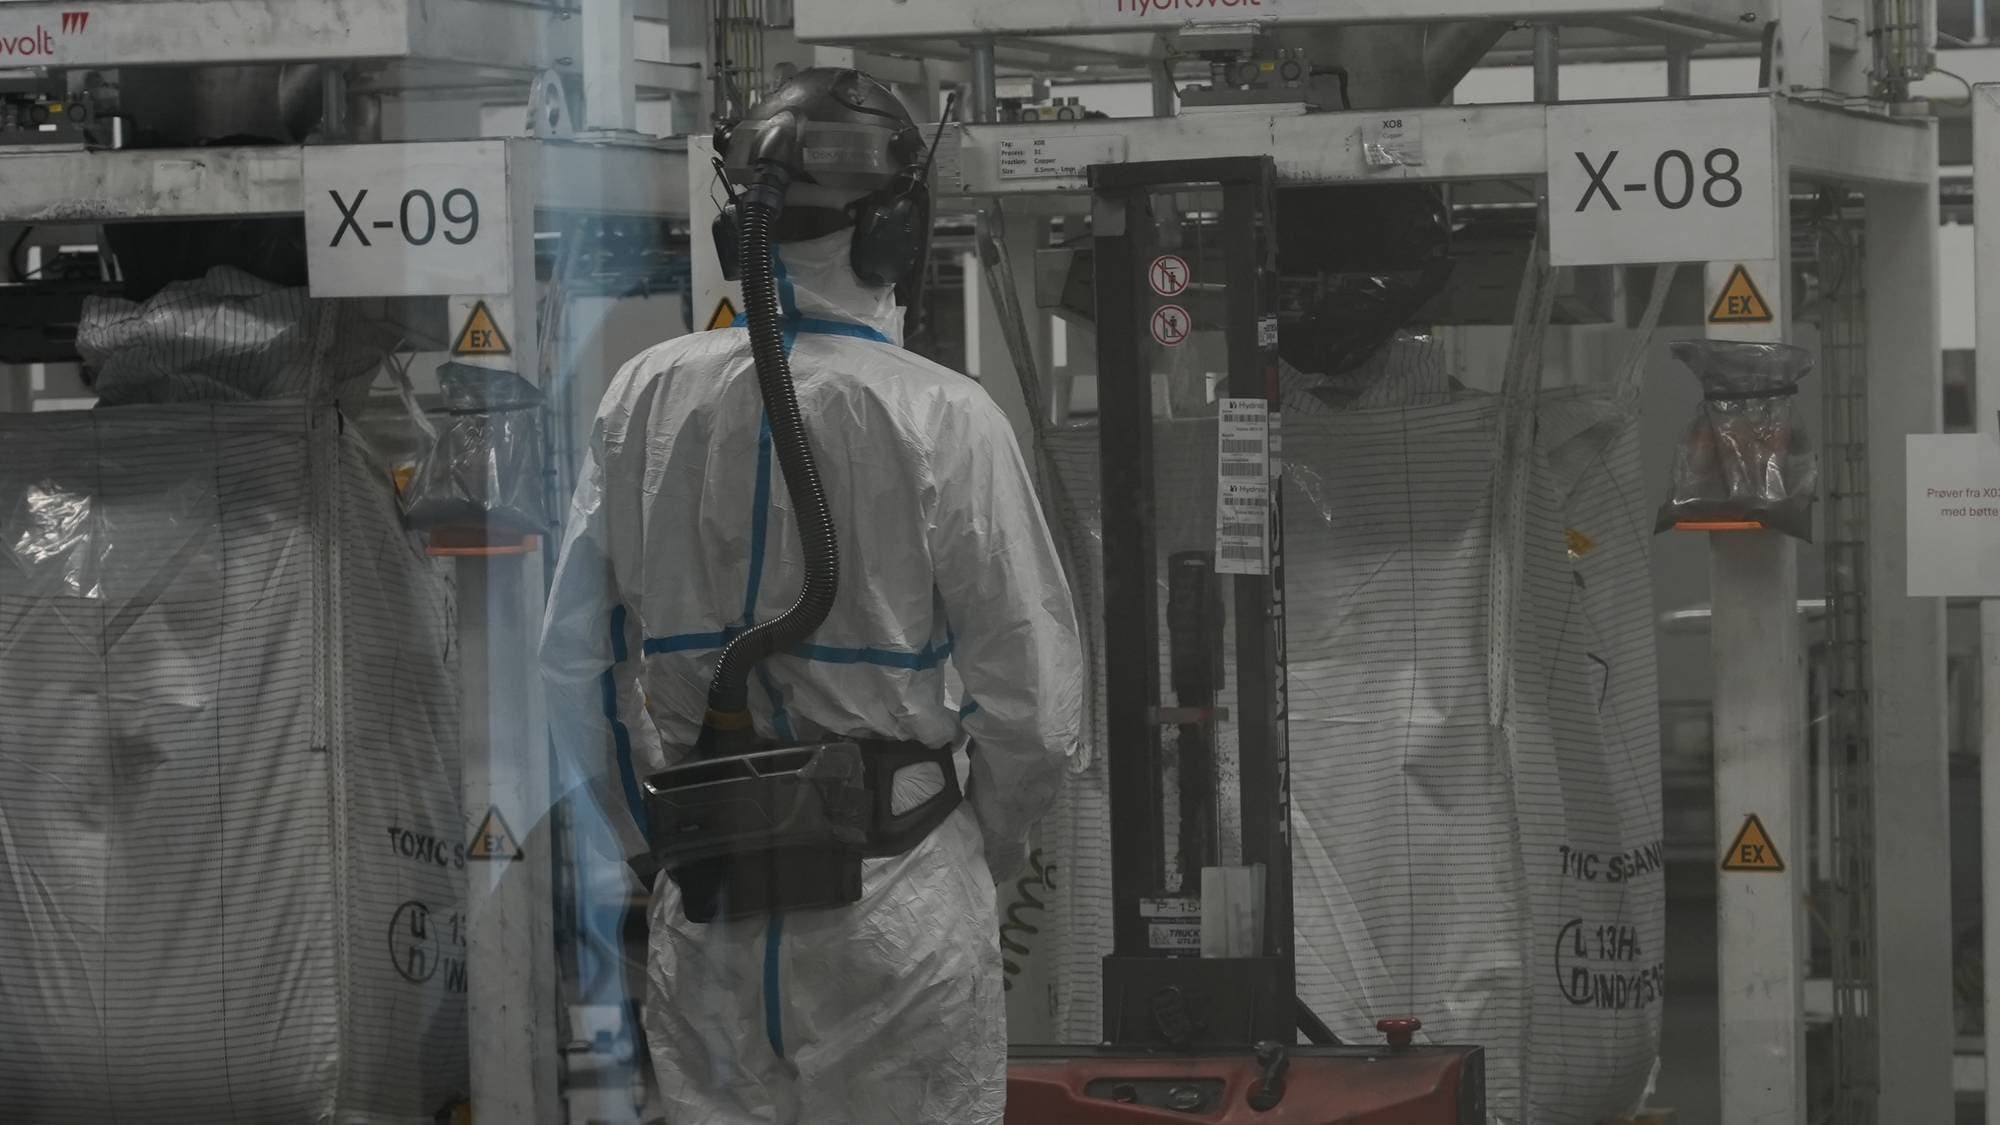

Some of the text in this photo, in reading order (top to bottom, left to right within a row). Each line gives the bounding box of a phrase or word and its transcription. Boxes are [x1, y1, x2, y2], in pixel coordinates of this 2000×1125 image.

[0, 25, 53, 55] volt
[1574, 148, 1742, 213] X-08
[329, 188, 479, 247] X-09
[1728, 295, 1752, 314] EX
[471, 330, 492, 348] EX
[1927, 488, 1964, 498] Prøver
[1966, 488, 1981, 498] fra
[1941, 507, 1998, 517] med bøtte
[387, 827, 449, 867] TOXIC
[484, 834, 505, 853] EX
[1741, 844, 1764, 864] EX
